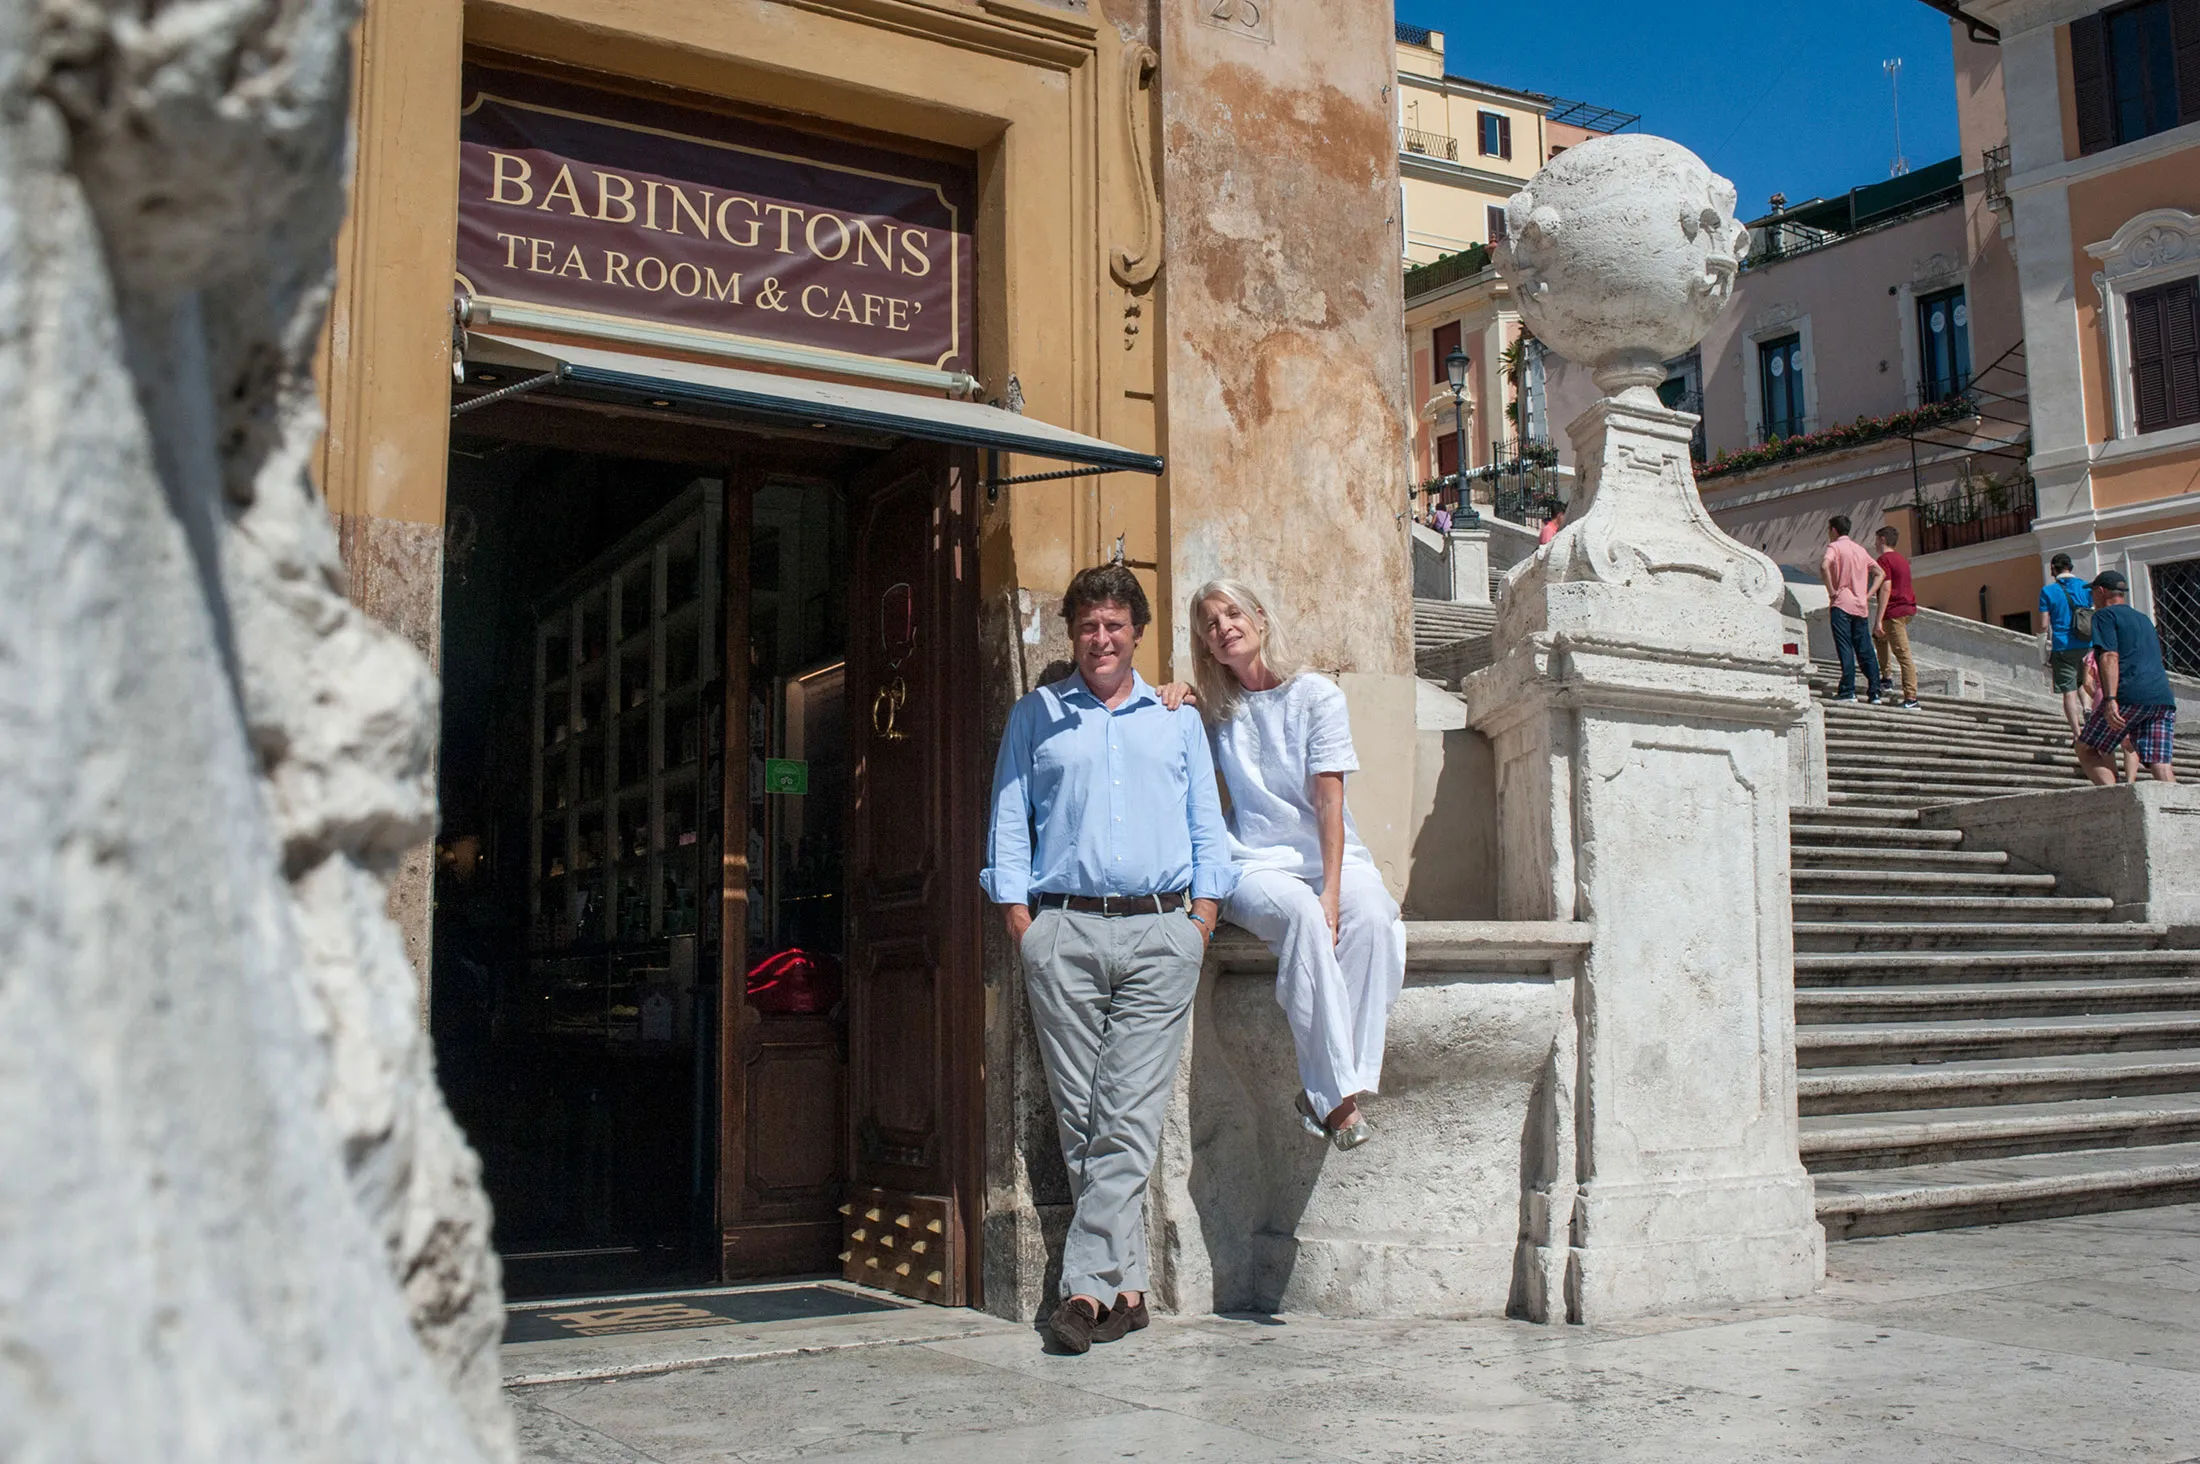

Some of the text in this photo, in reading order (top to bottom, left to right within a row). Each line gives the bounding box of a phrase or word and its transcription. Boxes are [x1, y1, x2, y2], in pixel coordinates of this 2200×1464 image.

[486, 151, 931, 276] BABINGTONS
[497, 232, 590, 281] TEA
[602, 249, 743, 304] ROOM
[755, 276, 789, 312] &
